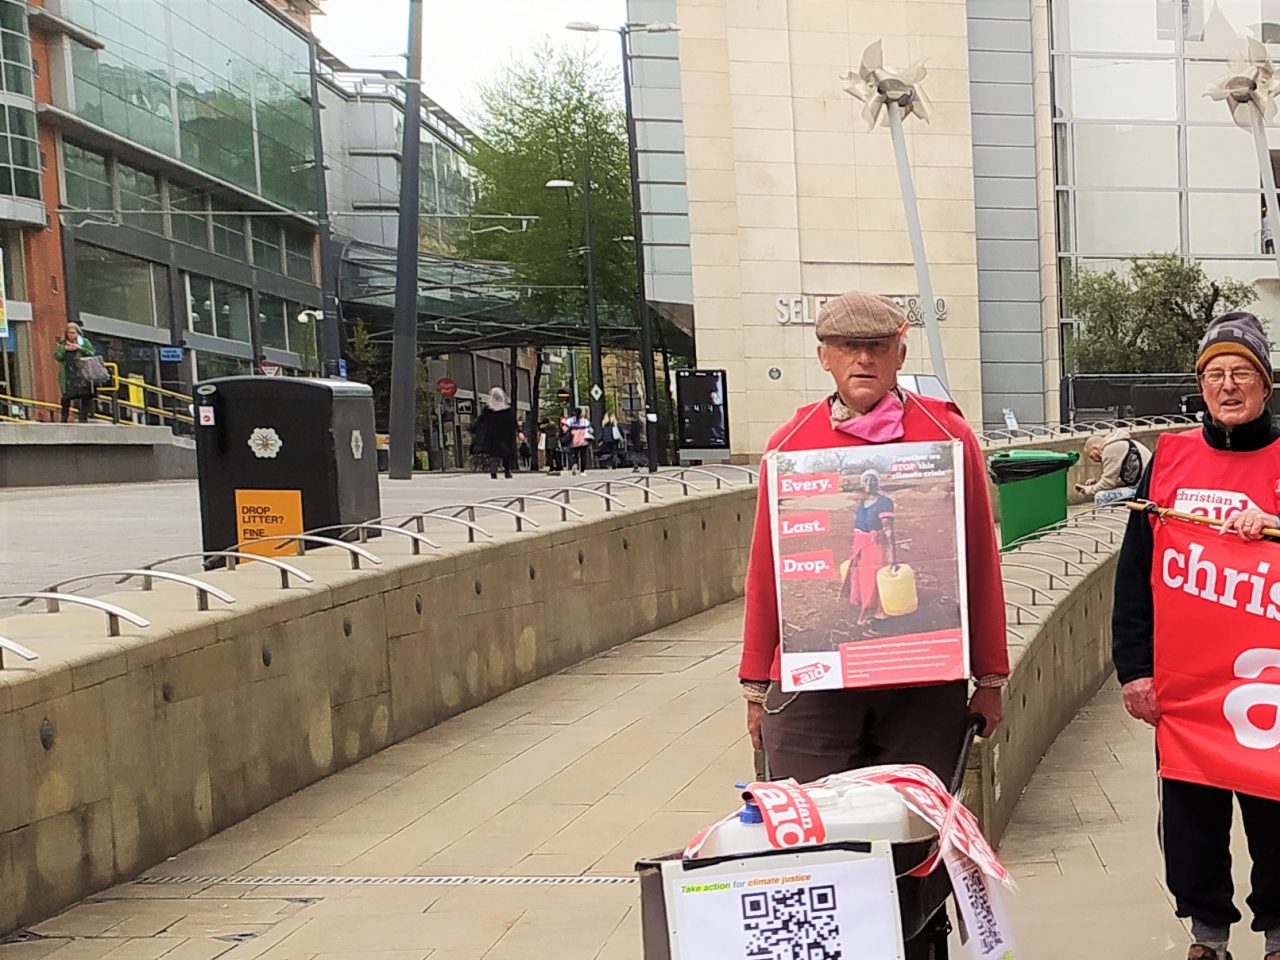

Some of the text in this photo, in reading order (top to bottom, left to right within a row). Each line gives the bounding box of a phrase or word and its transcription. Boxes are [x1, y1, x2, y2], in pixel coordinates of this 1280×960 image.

[891, 462, 917, 471] STOP
[781, 478, 833, 493] Every.
[1176, 491, 1233, 506] christian
[241, 505, 271, 515] DROP
[242, 515, 285, 524] LITTER?
[781, 520, 826, 535] Last.
[783, 558, 831, 574] Drop.
[799, 663, 827, 685] aid
[681, 873, 812, 893] Take action for climate justice
